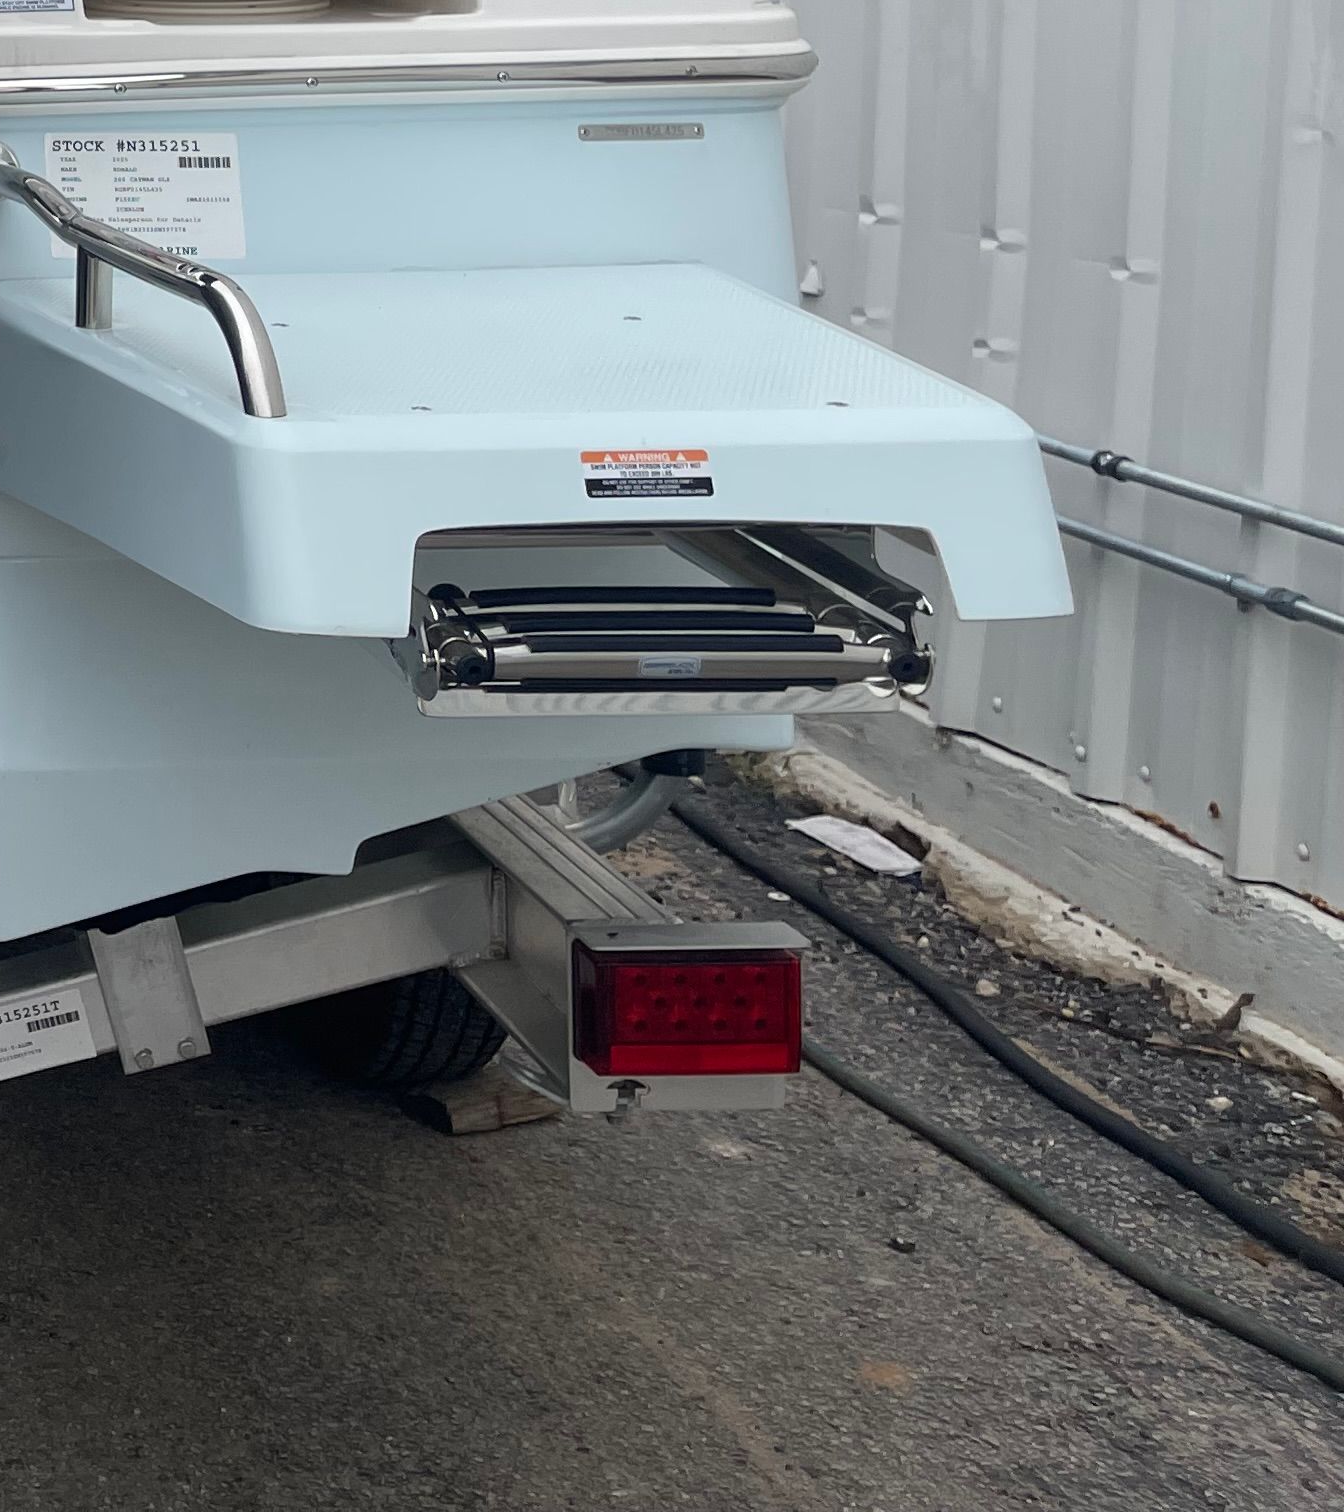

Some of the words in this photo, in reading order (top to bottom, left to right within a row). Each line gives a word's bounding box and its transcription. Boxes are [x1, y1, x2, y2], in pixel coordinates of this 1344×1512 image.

[52, 140, 106, 152] STOCK
[117, 139, 201, 152] #N315251
[617, 452, 671, 463] WARNING
